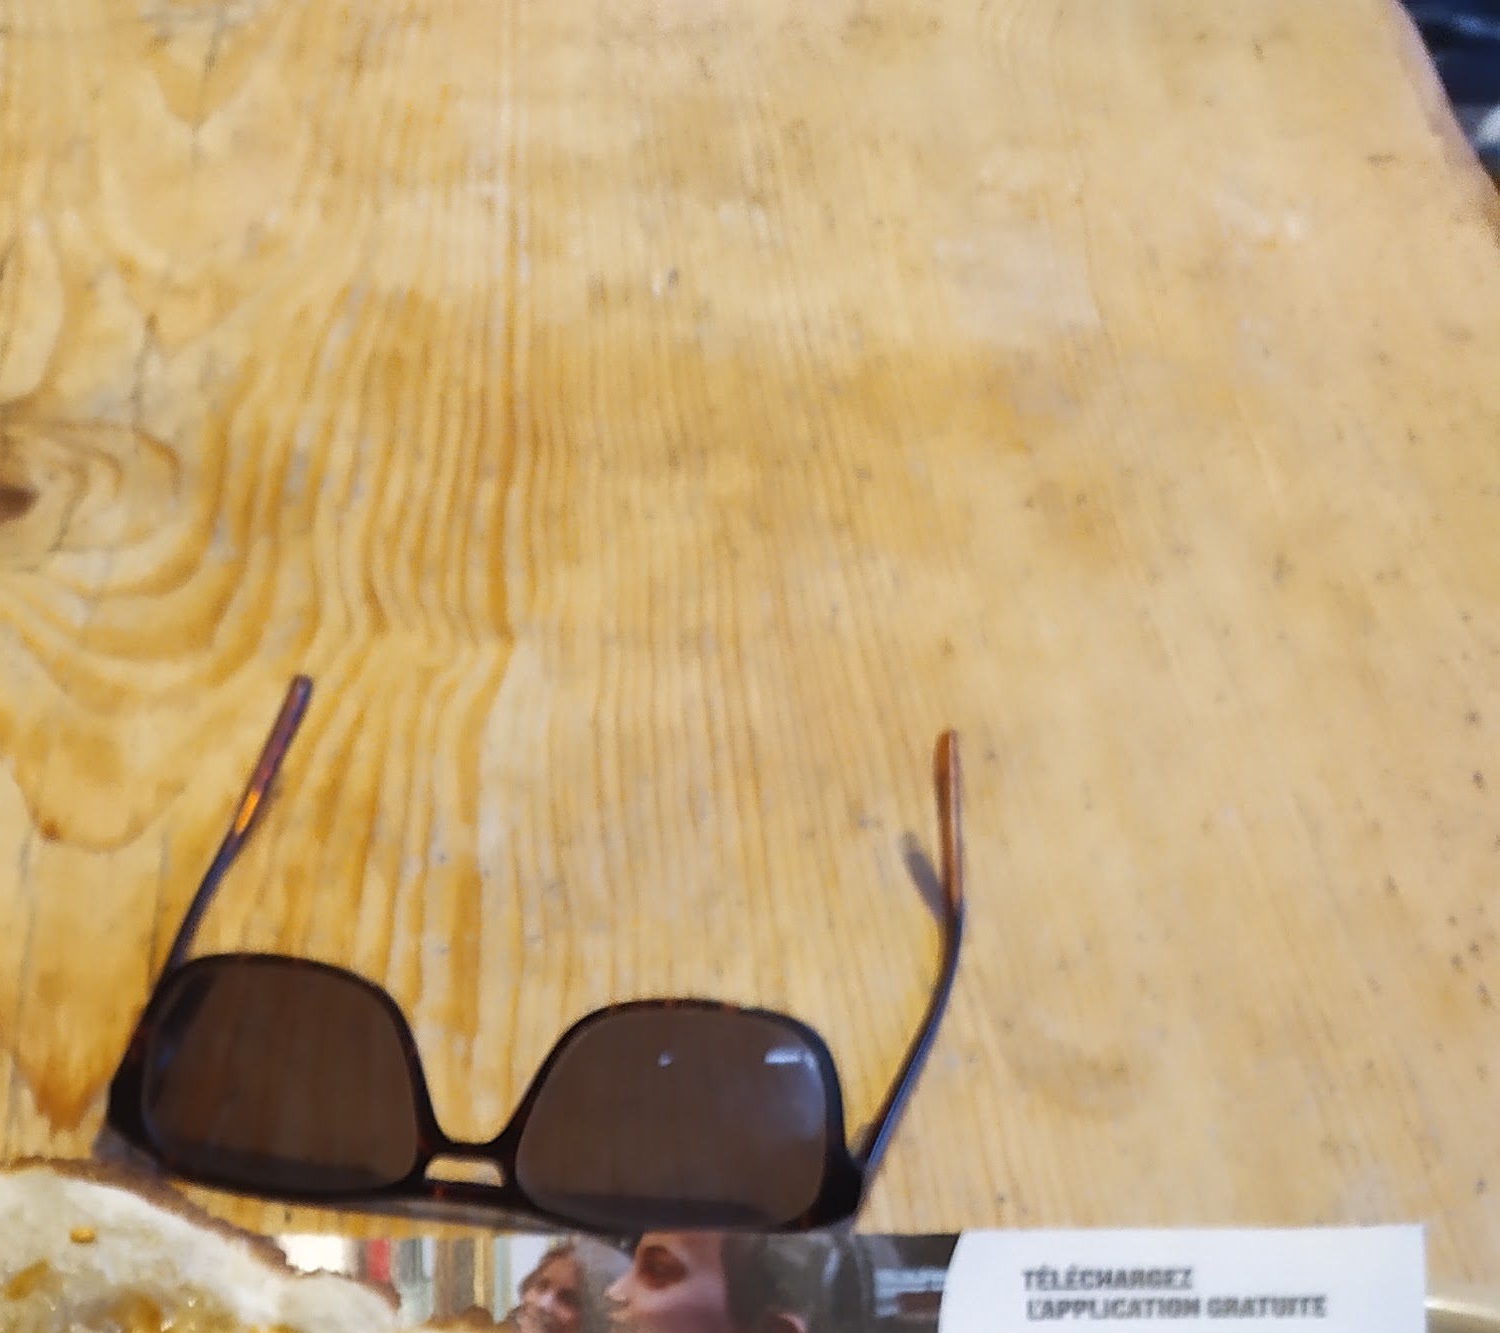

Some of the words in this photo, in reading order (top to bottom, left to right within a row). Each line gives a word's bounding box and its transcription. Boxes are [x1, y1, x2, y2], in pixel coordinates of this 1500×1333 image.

[1021, 1263, 1194, 1292] TÉLÉCHARGEZ
[1025, 1296, 1201, 1321] L'APPLICATION
[1205, 1293, 1329, 1319] GRATUITE
